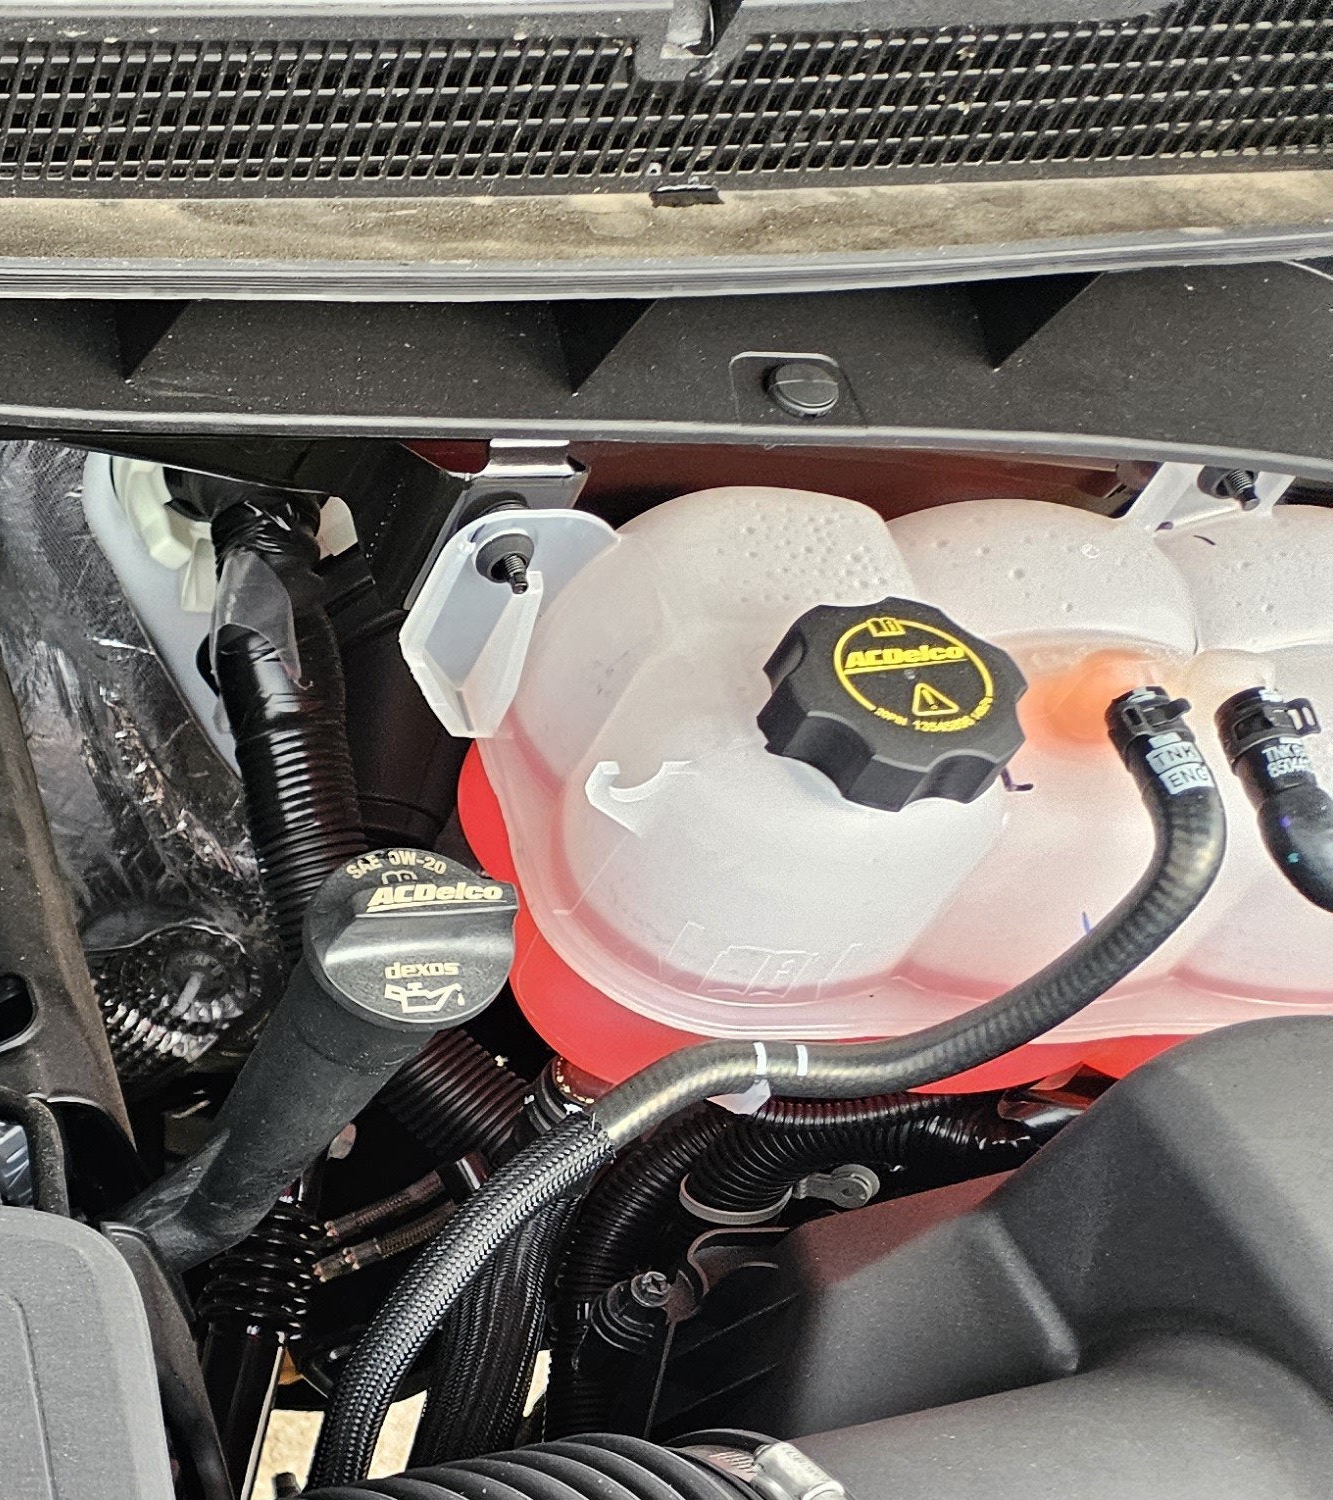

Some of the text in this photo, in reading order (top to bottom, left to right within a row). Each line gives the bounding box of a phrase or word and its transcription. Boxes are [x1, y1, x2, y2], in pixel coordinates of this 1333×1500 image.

[844, 644, 965, 669] ACDelco
[346, 850, 447, 880] SAE 0W-20
[366, 881, 504, 907] ACDelco
[384, 961, 461, 980] dexos
